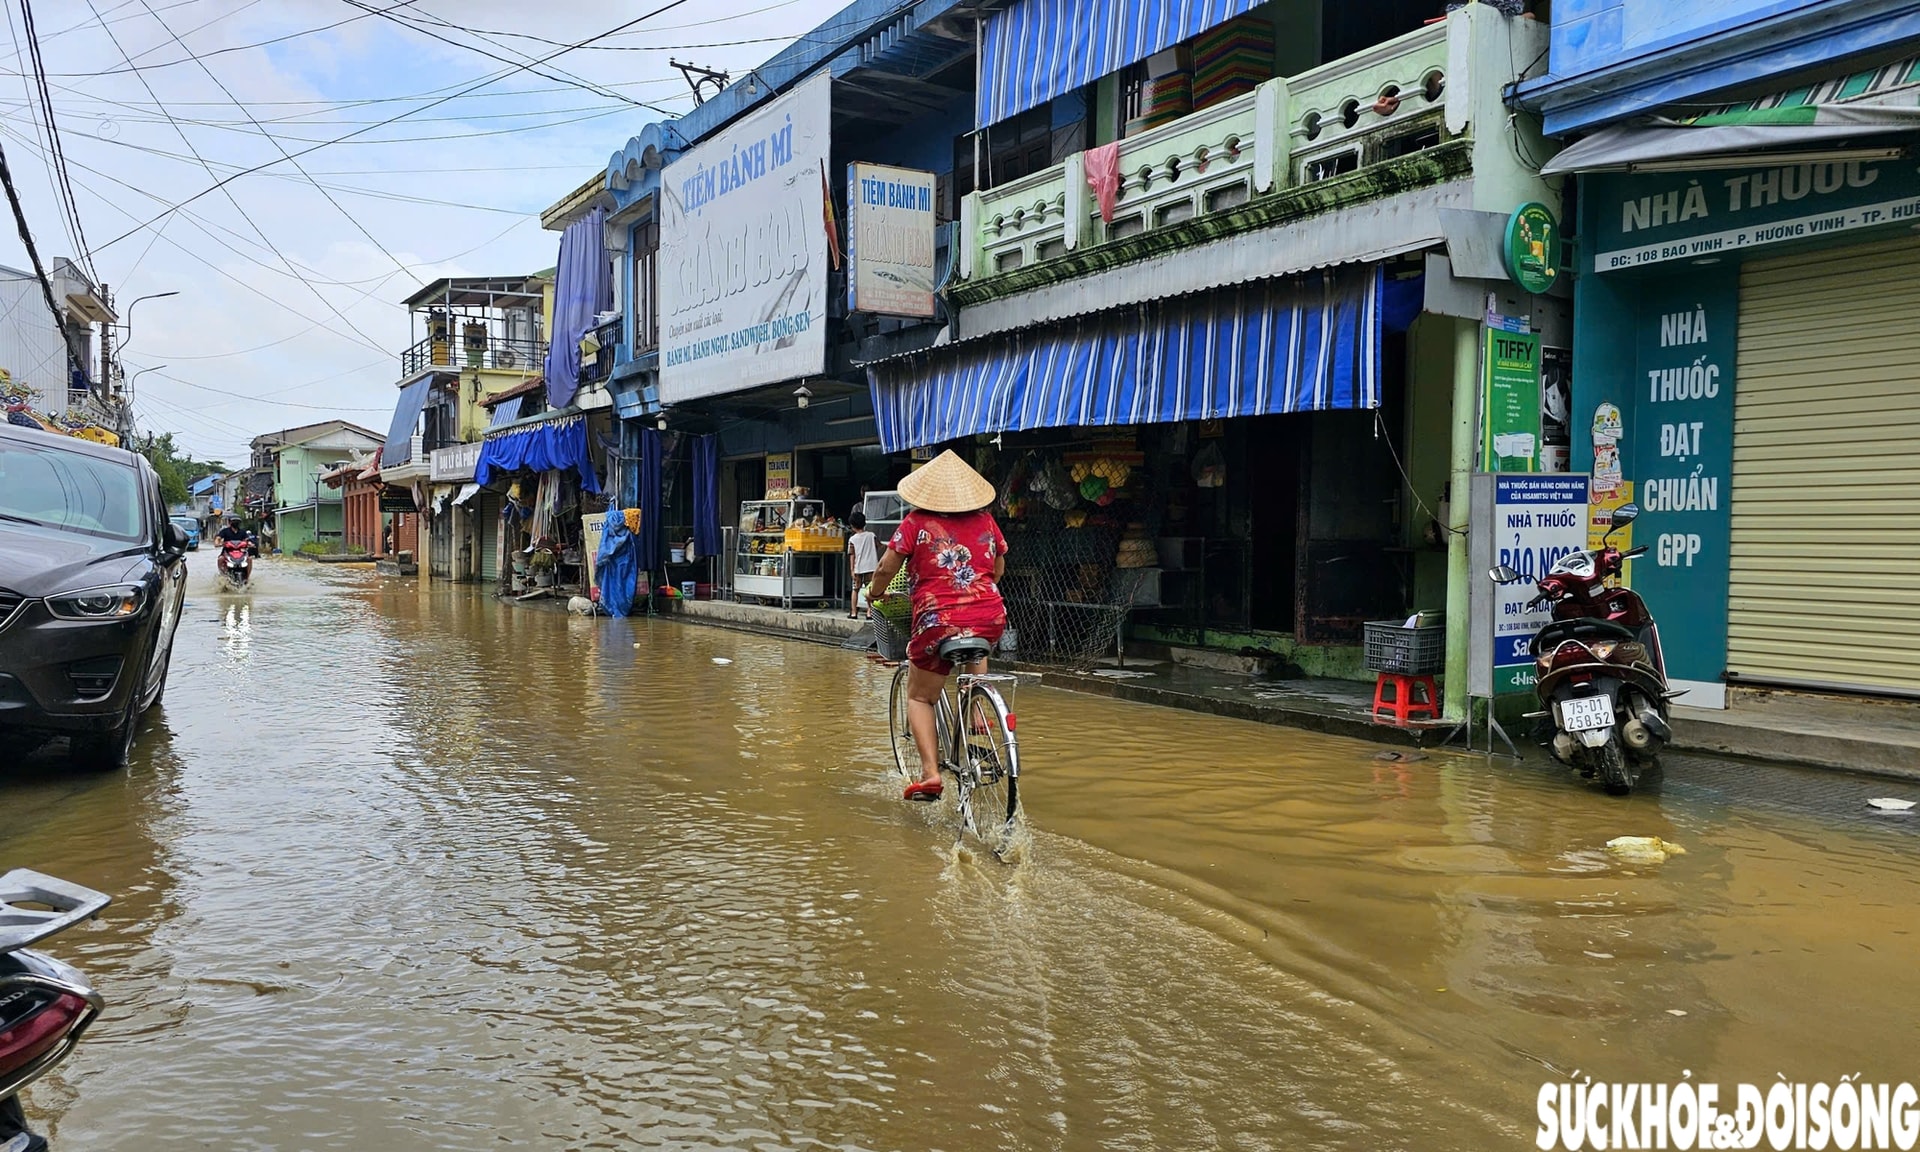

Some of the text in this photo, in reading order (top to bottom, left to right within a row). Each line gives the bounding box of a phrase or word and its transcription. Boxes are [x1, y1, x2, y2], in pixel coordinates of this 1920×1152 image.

[682, 162, 717, 216] TIỆM
[719, 144, 767, 196] BÁNH
[861, 175, 931, 212] TIỆM BÁNH MÌ
[1622, 179, 1709, 233] NHÀ
[1610, 254, 1631, 268] ĐC:
[1635, 250, 1658, 264] 108
[1662, 244, 1688, 259] BAO
[1692, 238, 1723, 254] VINH
[1737, 234, 1750, 246] P.
[1755, 223, 1804, 242] HƯƠNG
[1809, 216, 1845, 233] VINH
[1862, 210, 1886, 224] TP.
[772, 314, 793, 339] BÔNG
[794, 310, 812, 333] SEN
[1660, 303, 1708, 347] NHÀ
[1496, 339, 1534, 361] TIFFY
[1648, 355, 1720, 402] THUỐC
[1660, 422, 1703, 462] ĐẠT
[1643, 463, 1718, 512] CHUẨN
[1507, 510, 1532, 528] NHÀ
[1536, 508, 1576, 528] THUỐC
[1500, 532, 1534, 586] BẢO
[1657, 533, 1702, 567] GPP
[1504, 602, 1524, 617] ĐẠT
[1567, 711, 1611, 730] 258.52
